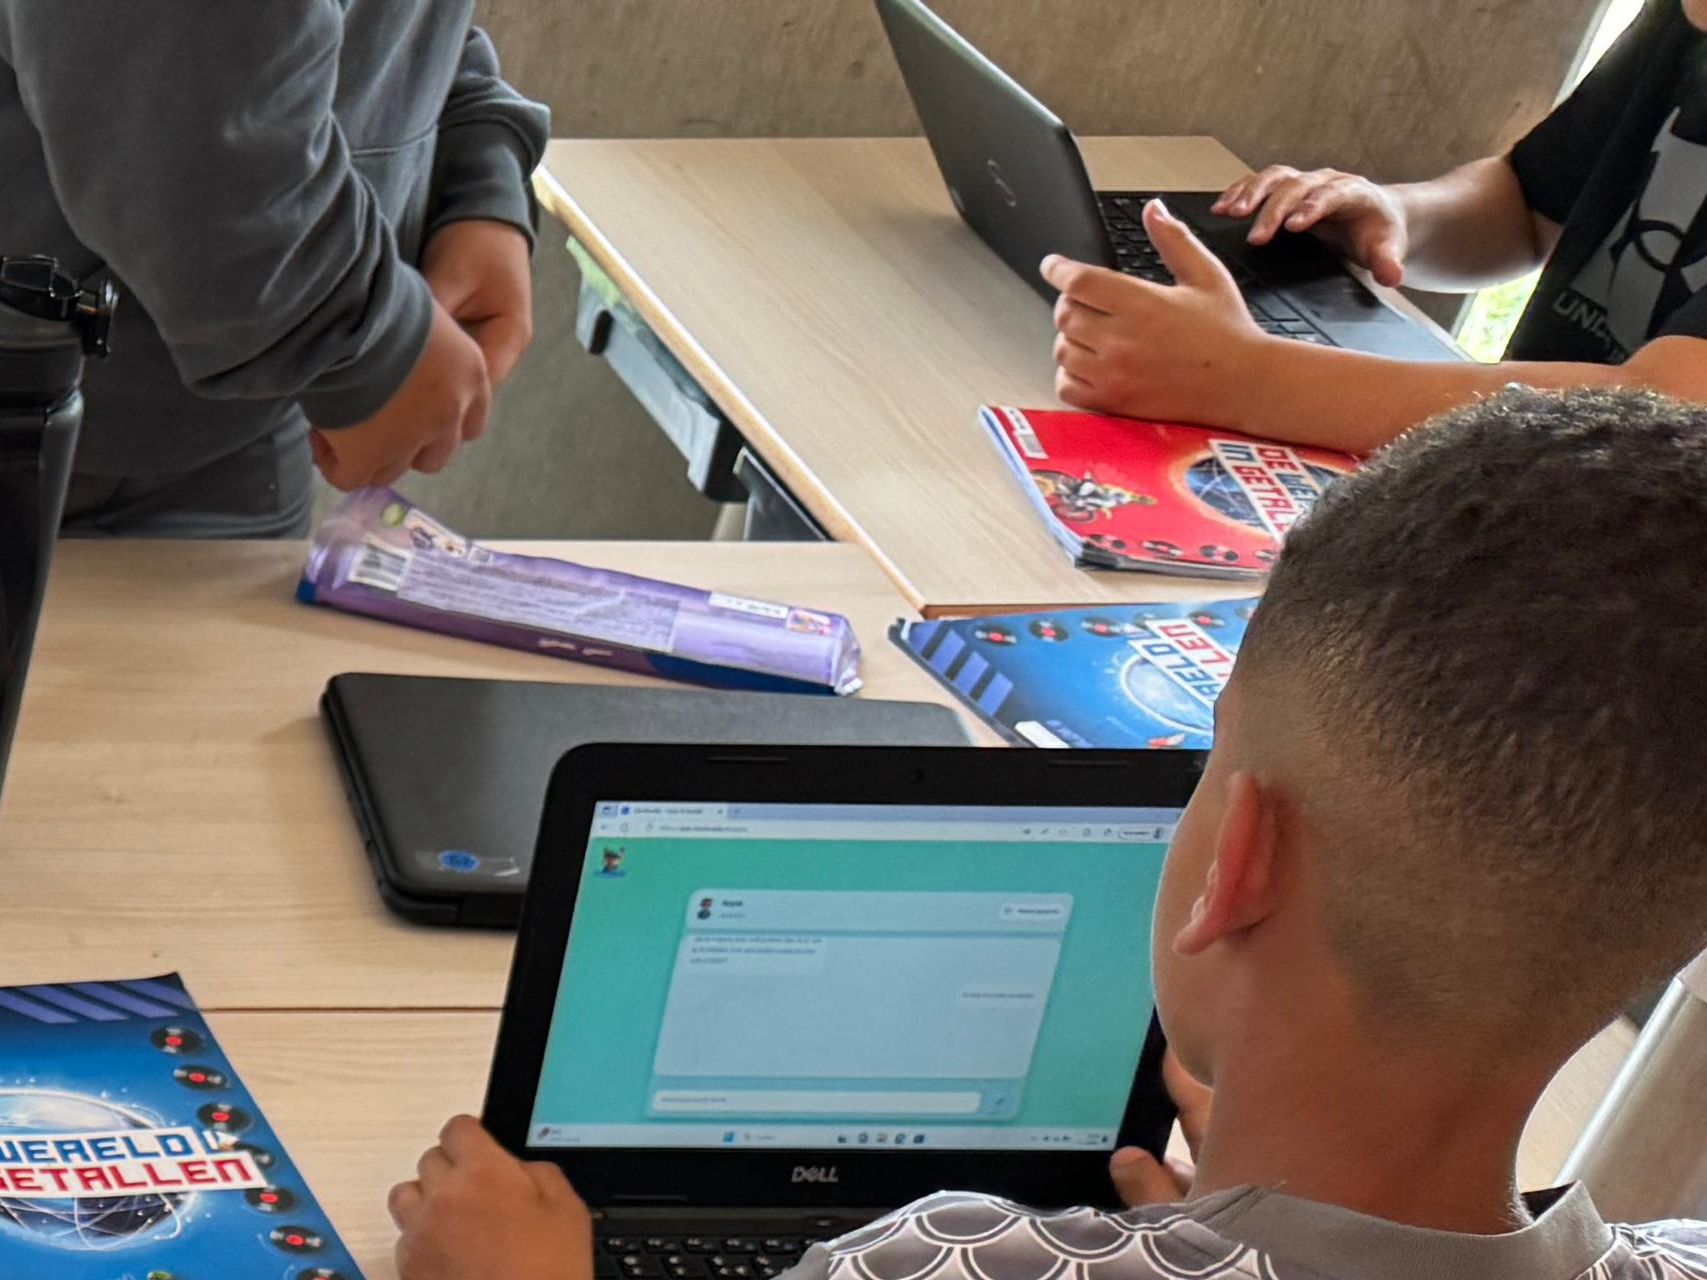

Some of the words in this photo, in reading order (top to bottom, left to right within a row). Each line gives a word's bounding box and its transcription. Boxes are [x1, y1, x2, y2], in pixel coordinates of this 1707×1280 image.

[1217, 443, 1258, 462] IN
[1256, 446, 1301, 471] DE
[791, 1165, 839, 1183] DELL
